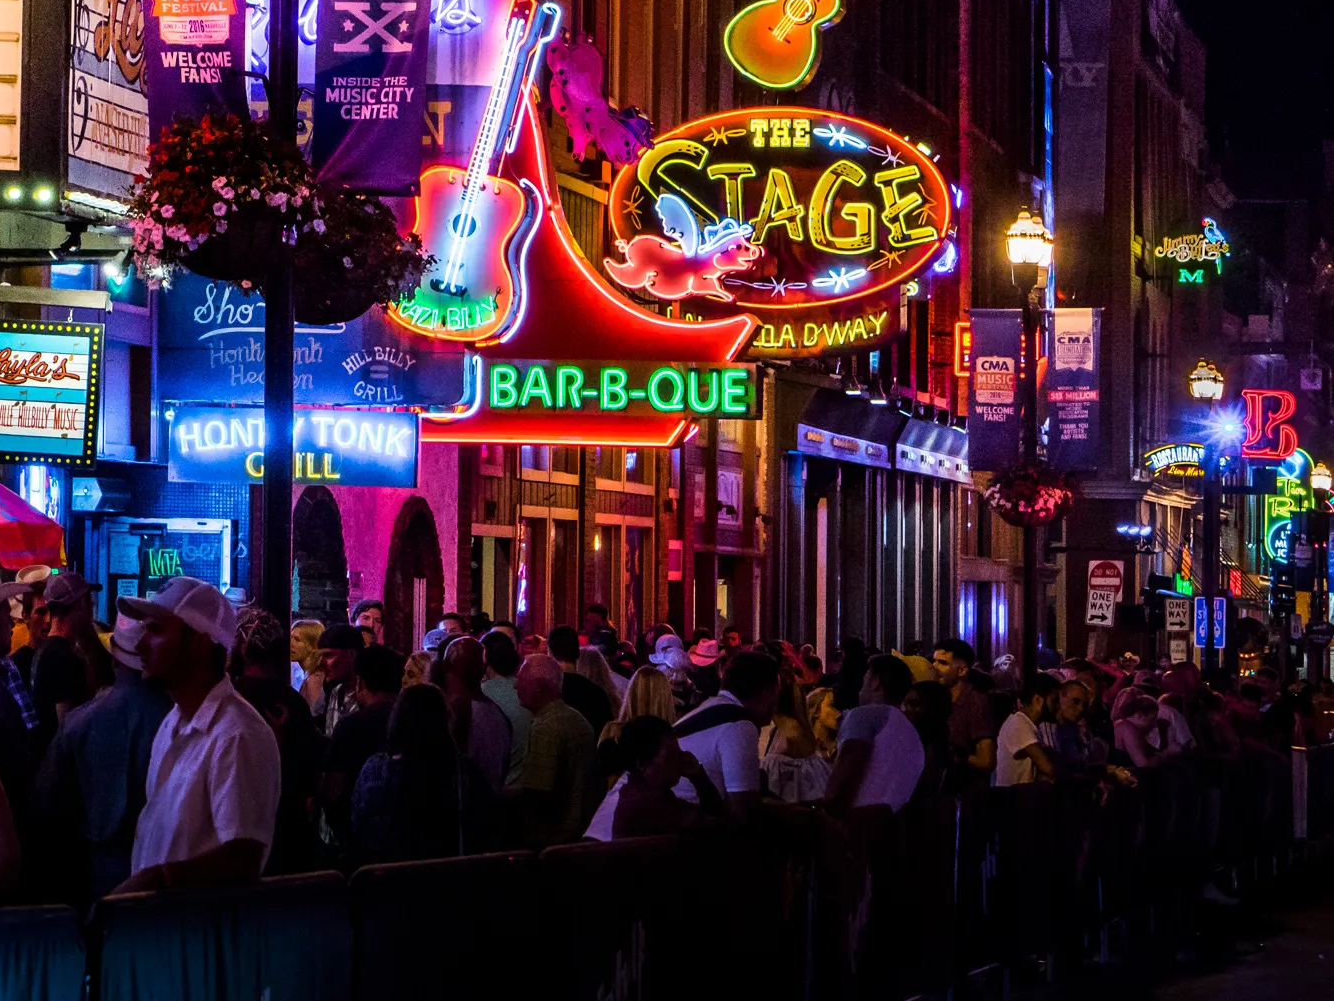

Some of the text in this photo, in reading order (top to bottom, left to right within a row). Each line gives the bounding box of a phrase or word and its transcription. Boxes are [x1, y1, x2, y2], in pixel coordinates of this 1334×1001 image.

[162, 2, 227, 13] FESTIVAL
[189, 20, 205, 33] 2016
[333, 2, 417, 52] X
[160, 52, 232, 67] WELCOME
[180, 68, 222, 83] FANS!
[332, 77, 407, 86] INSIDE THE
[325, 87, 414, 103] MUSIC CITY
[340, 105, 399, 120] CENTER
[750, 119, 811, 148] THE
[637, 138, 938, 256] STAGE
[1155, 234, 1204, 257] Jimmy
[753, 310, 888, 348] OADWAY
[342, 346, 417, 375] HILL BILLY
[981, 360, 1010, 371] CMA
[977, 374, 1014, 385] MUSIC
[354, 381, 404, 402] GRILL
[489, 364, 748, 413] BAR-B-QUE
[1065, 391, 1096, 400] MILLION
[18, 405, 50, 430] HILLBILLY
[53, 406, 79, 431] MUSIC
[975, 406, 1014, 415] WELCOME
[983, 414, 1006, 422] FANS!
[1242, 389, 1298, 459] B
[312, 417, 412, 457] TONK
[245, 452, 341, 479] GILL
[1094, 568, 1118, 576] DO NOT
[1091, 591, 1111, 602] ONE
[1090, 601, 1112, 612] WAY
[1168, 601, 1187, 610] ONE
[1168, 610, 1187, 618] WAY
